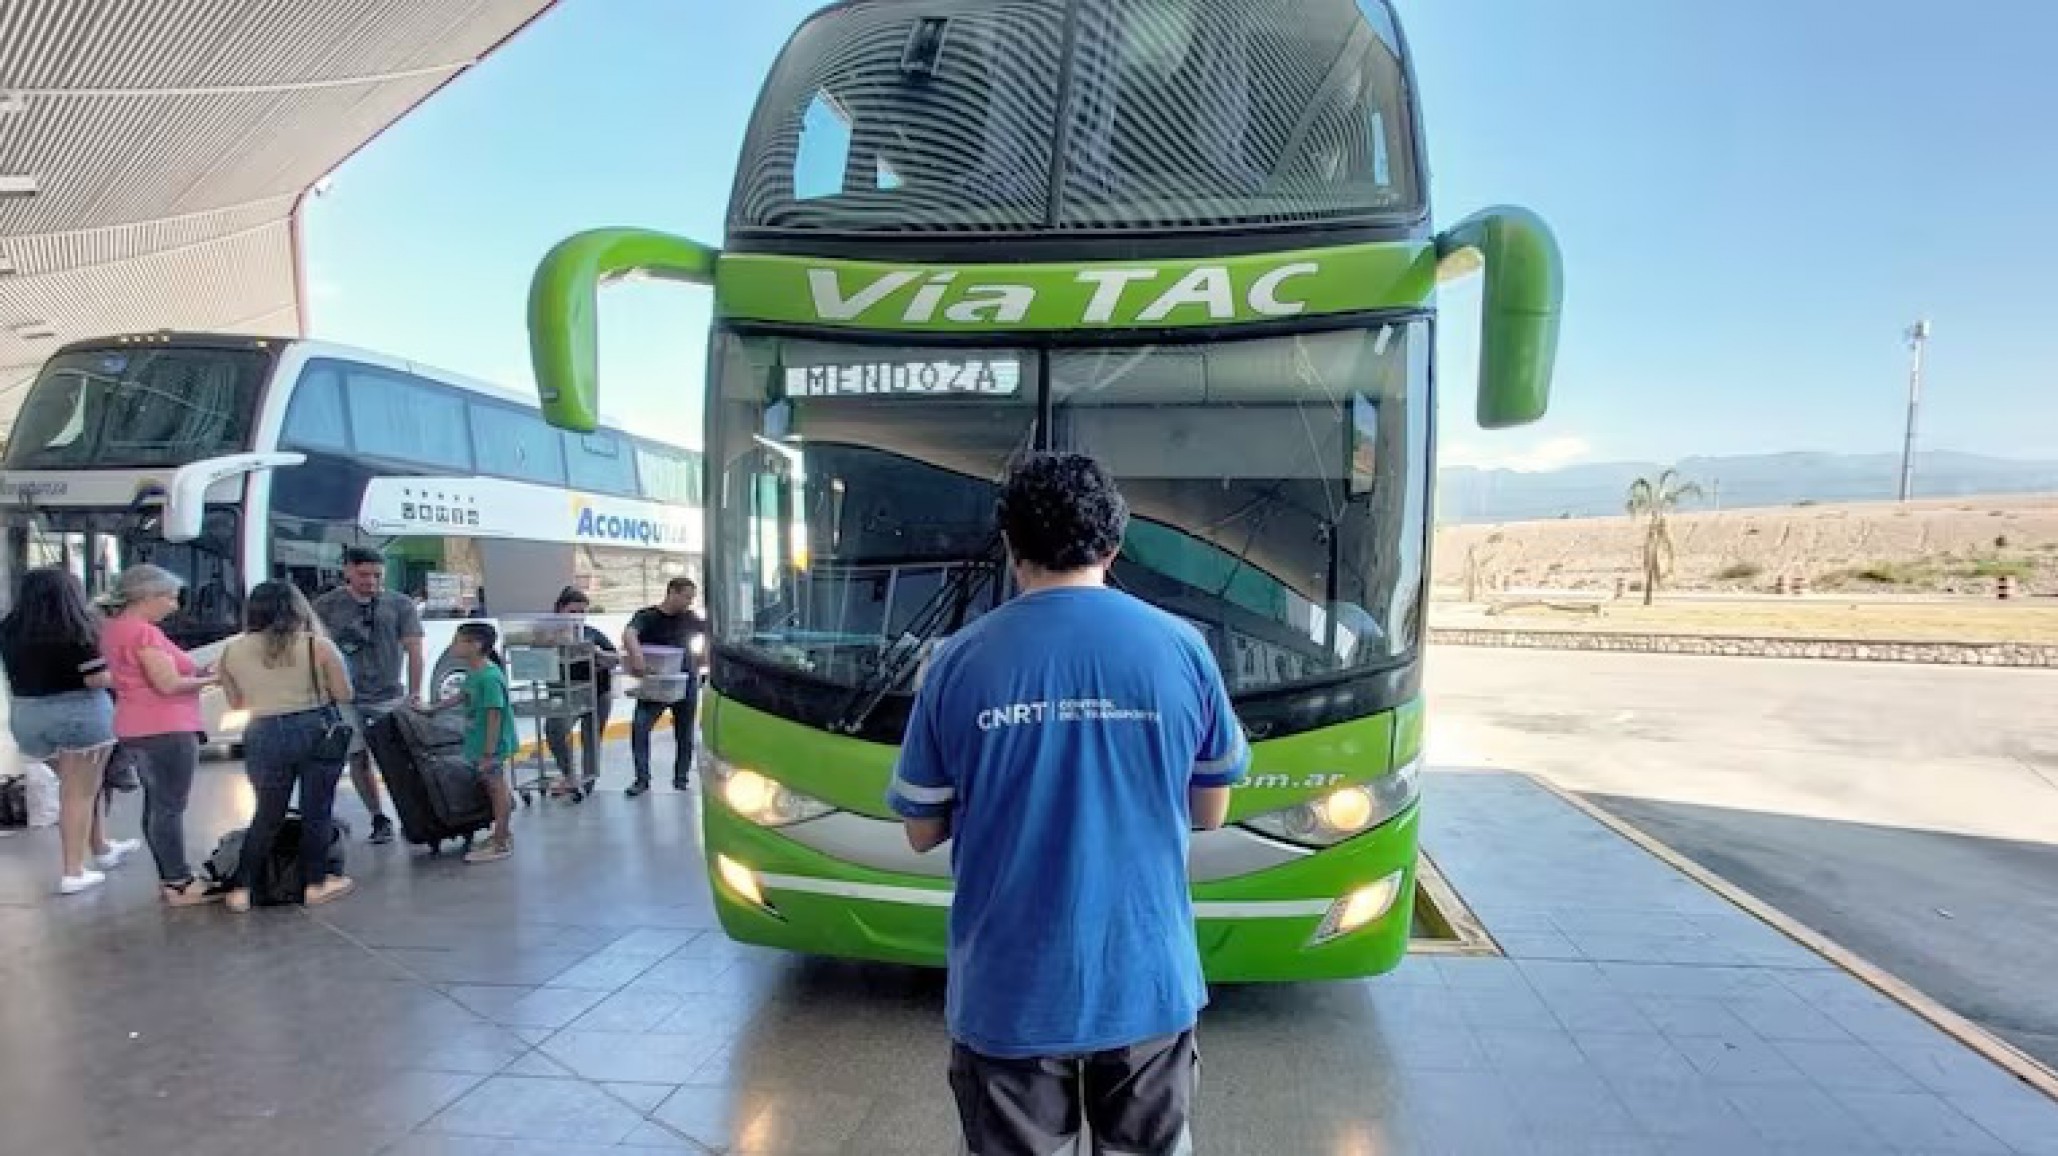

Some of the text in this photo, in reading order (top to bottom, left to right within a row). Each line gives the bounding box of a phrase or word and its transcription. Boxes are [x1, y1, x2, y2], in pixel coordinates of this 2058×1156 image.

[1075, 262, 1319, 323] TAC
[806, 361, 999, 396] MENDOZA
[575, 506, 688, 546] ACONQU
[976, 701, 1047, 732] CNRT
